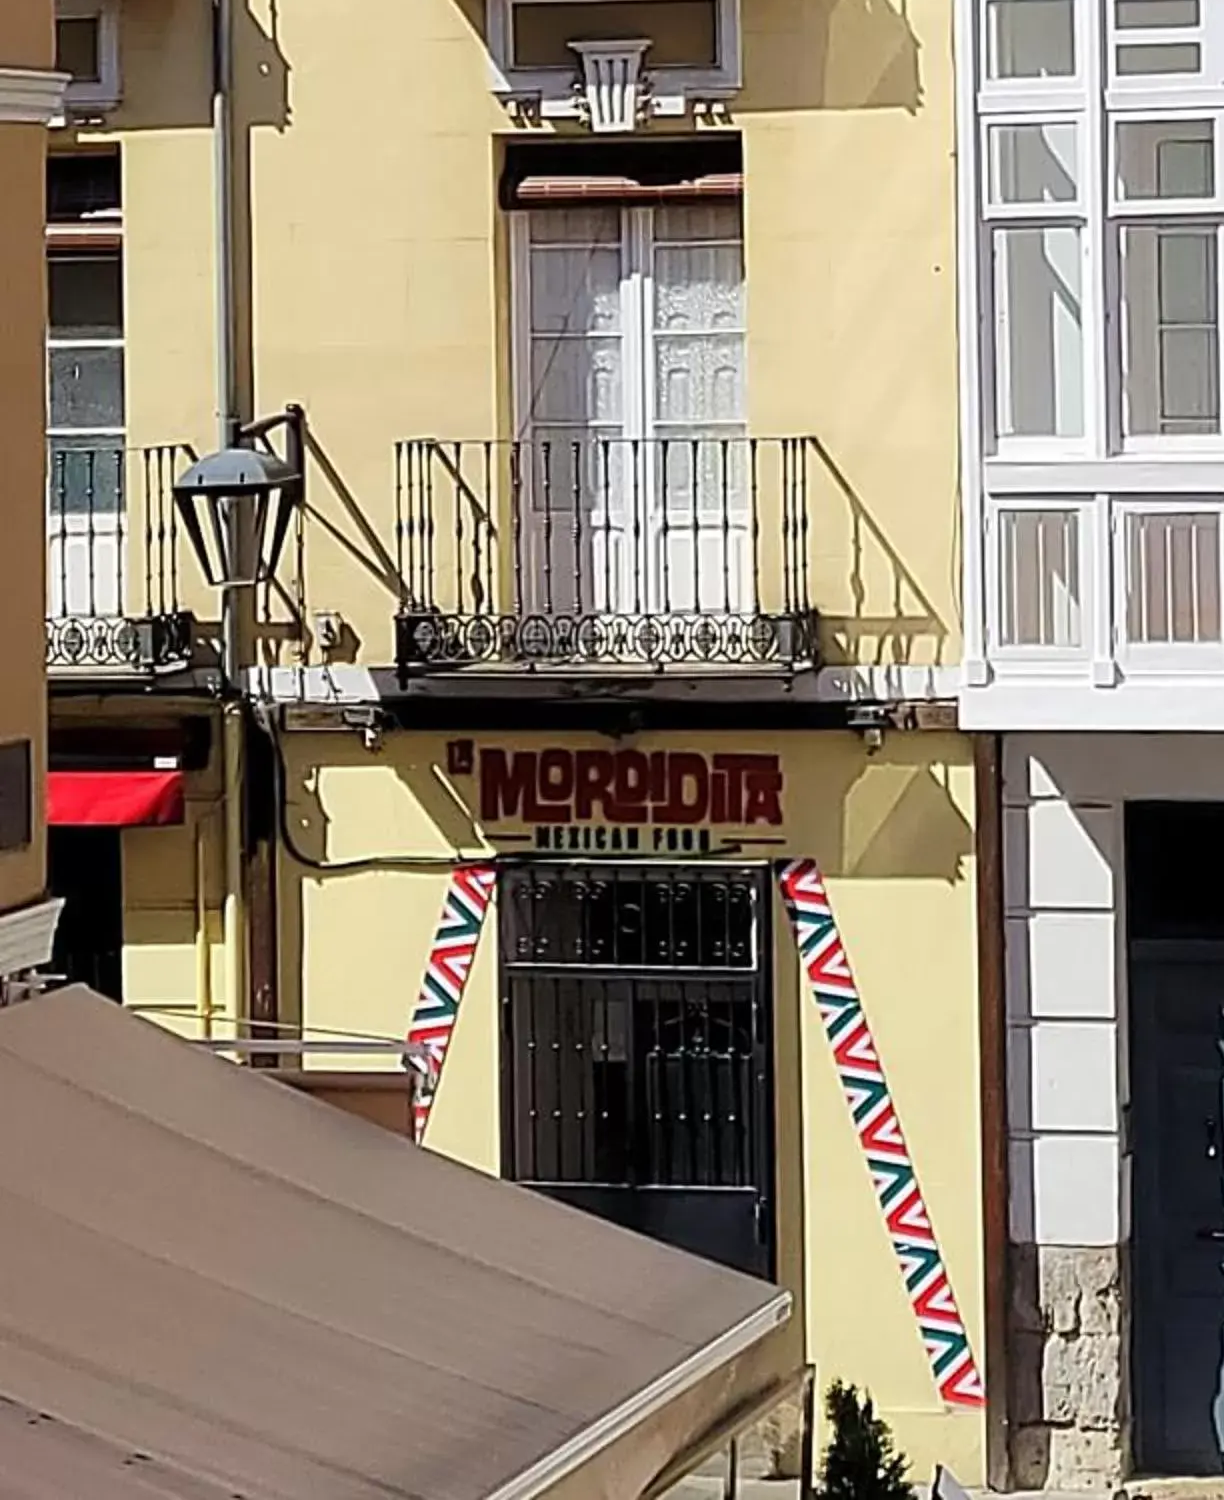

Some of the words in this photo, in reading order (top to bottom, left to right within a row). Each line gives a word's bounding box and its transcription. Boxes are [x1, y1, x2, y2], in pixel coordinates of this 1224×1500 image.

[447, 739, 474, 775] LA
[480, 747, 783, 825] MORDIDITA
[535, 825, 639, 850] MEXICAN
[652, 827, 711, 852] FOOD
